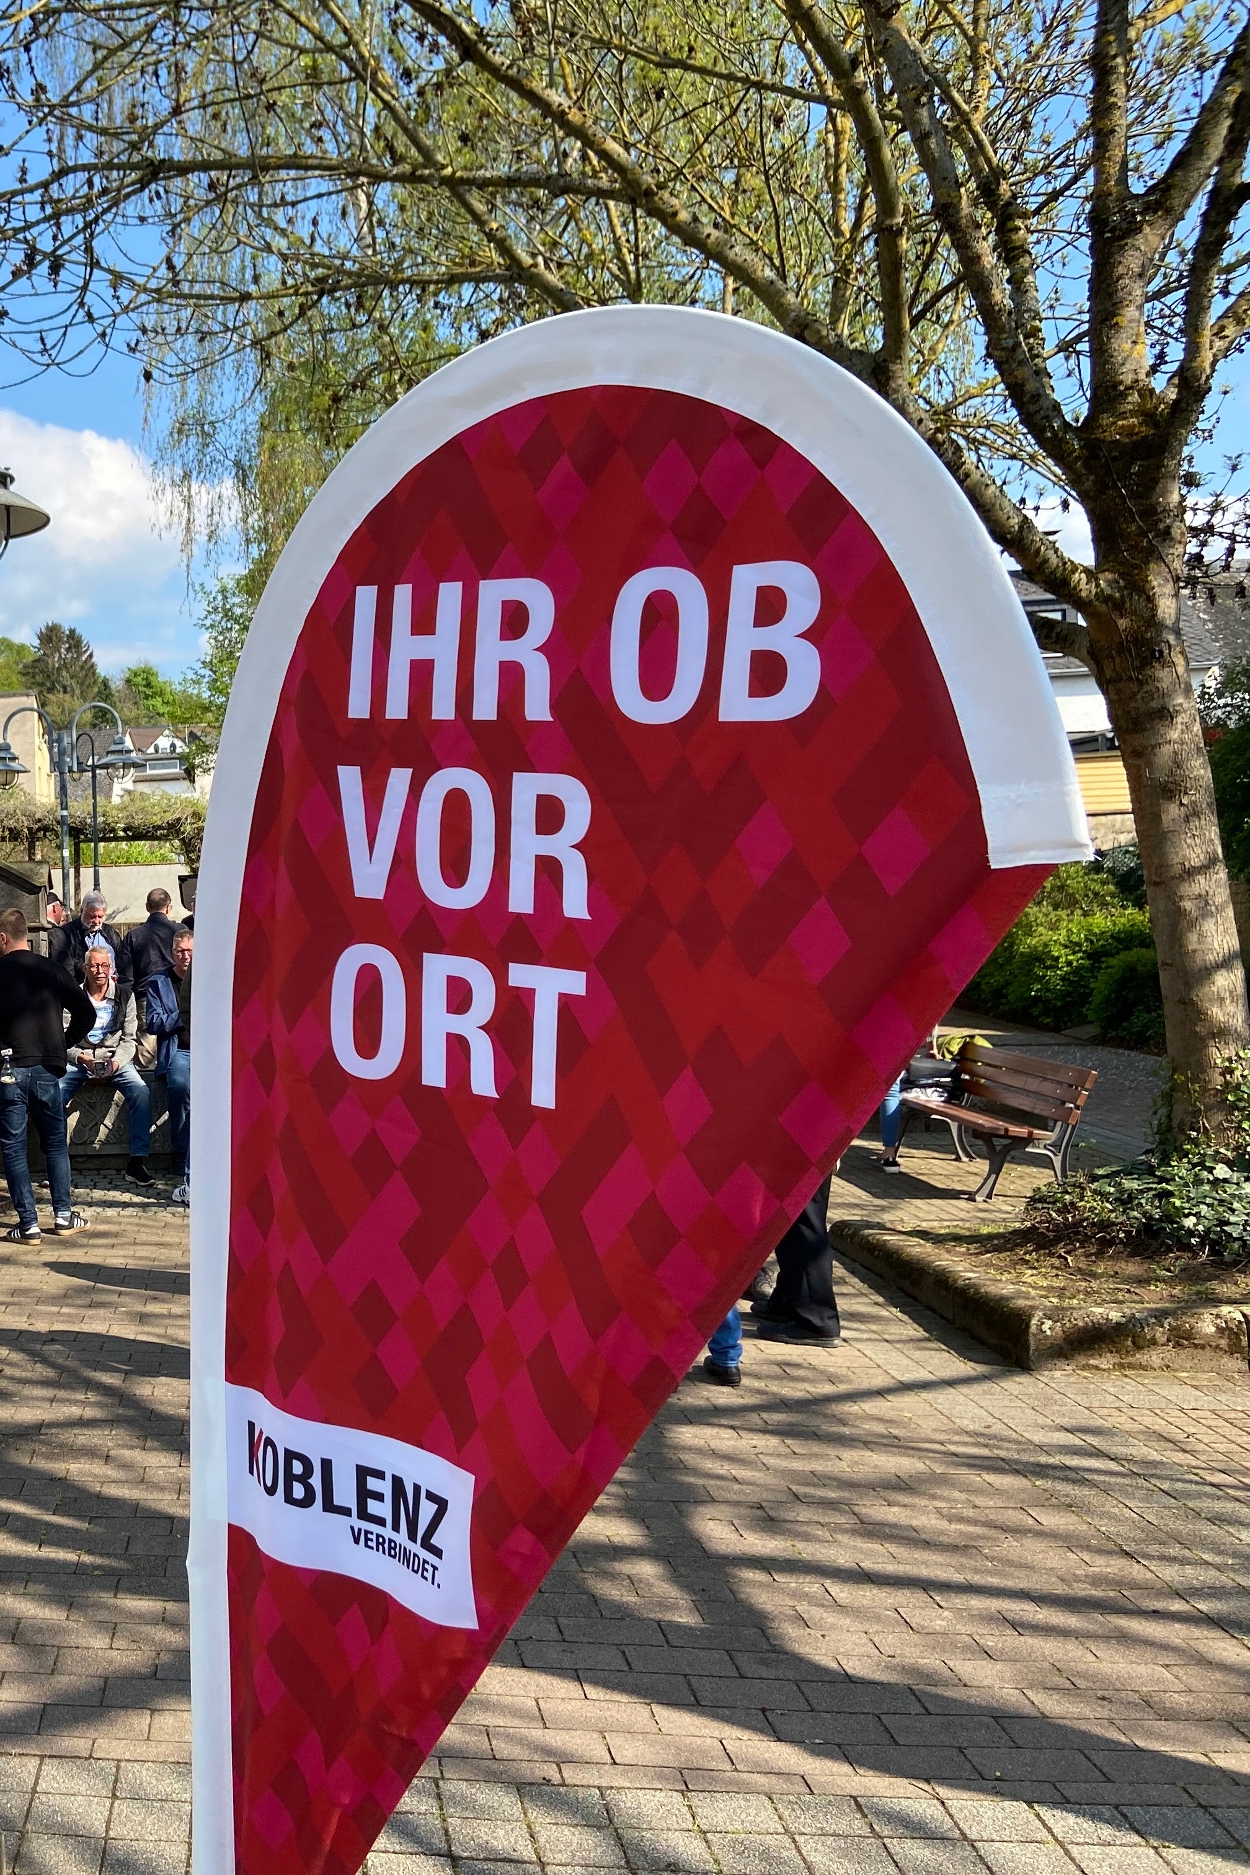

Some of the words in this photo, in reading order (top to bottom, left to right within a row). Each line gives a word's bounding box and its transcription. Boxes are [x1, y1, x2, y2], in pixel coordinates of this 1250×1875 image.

[347, 577, 555, 722] IHR
[609, 560, 822, 725] OB
[336, 765, 592, 920] VOR
[330, 943, 587, 1110] ORT
[247, 1419, 449, 1561] KOBLENZ
[350, 1525, 441, 1589] VERBINDET.
